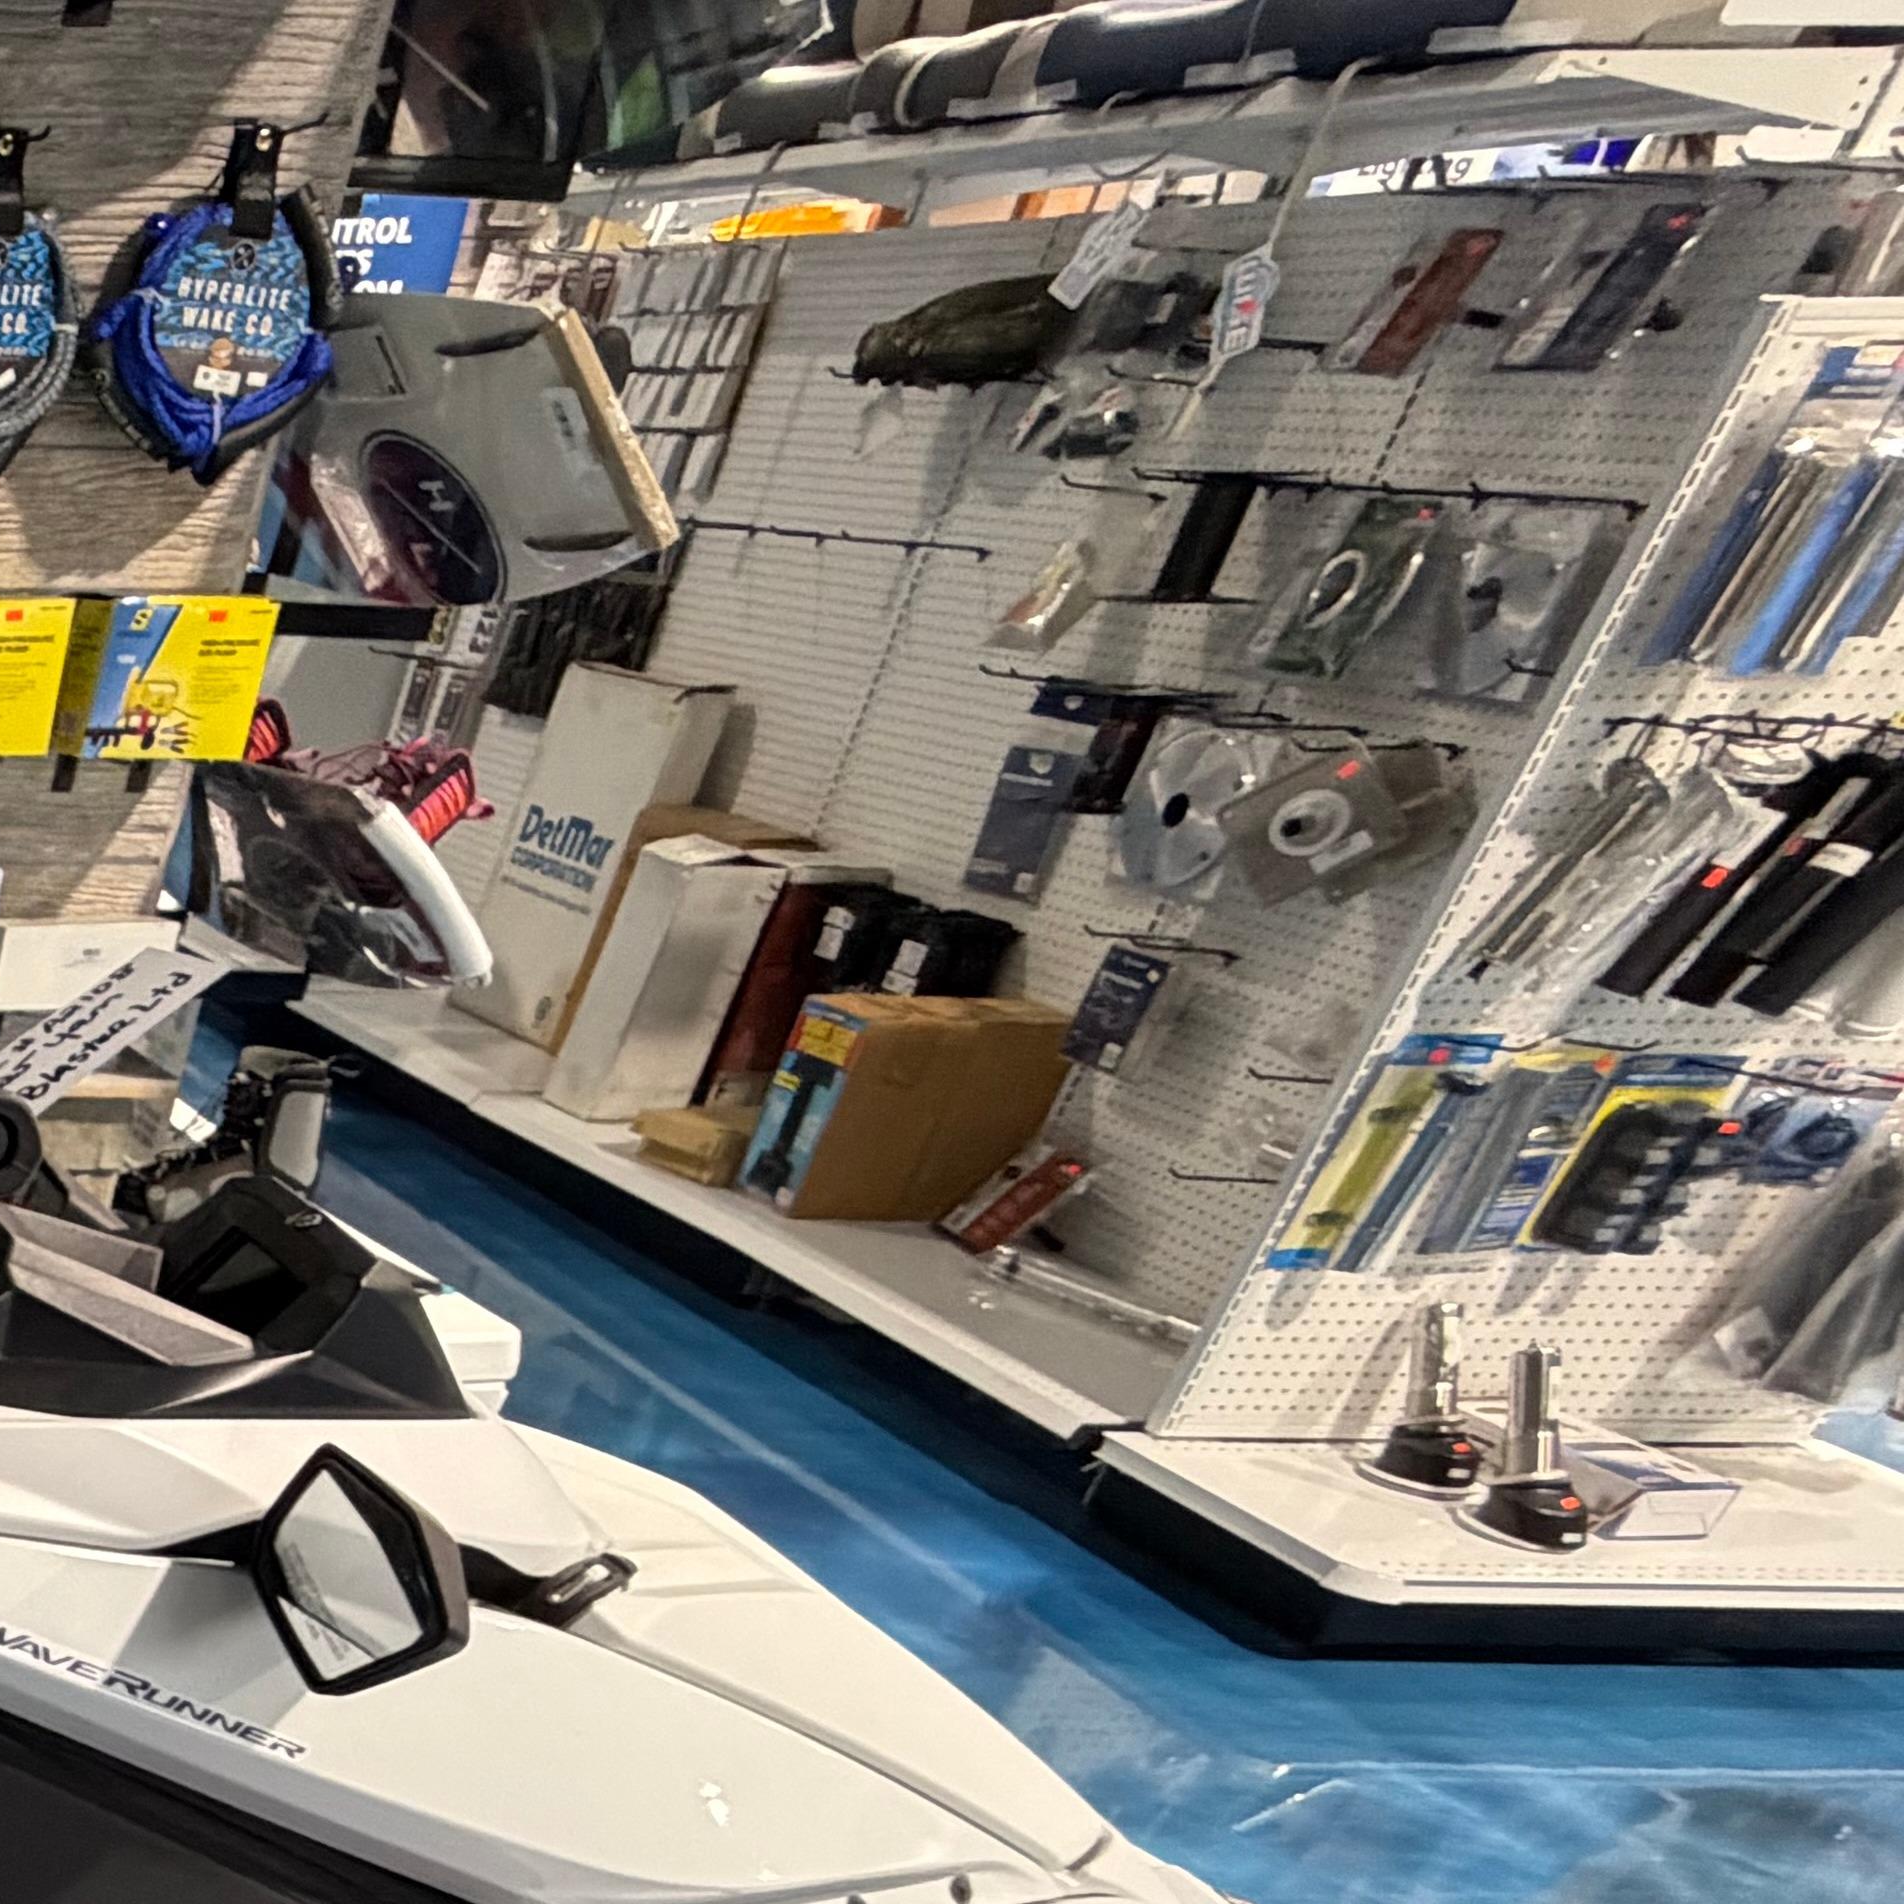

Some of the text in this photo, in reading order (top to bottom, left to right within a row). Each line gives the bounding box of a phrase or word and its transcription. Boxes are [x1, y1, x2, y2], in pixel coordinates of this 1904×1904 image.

[177, 276, 291, 311] HYPERLITE
[181, 307, 236, 333] WAKE
[518, 803, 616, 871] DetMar
